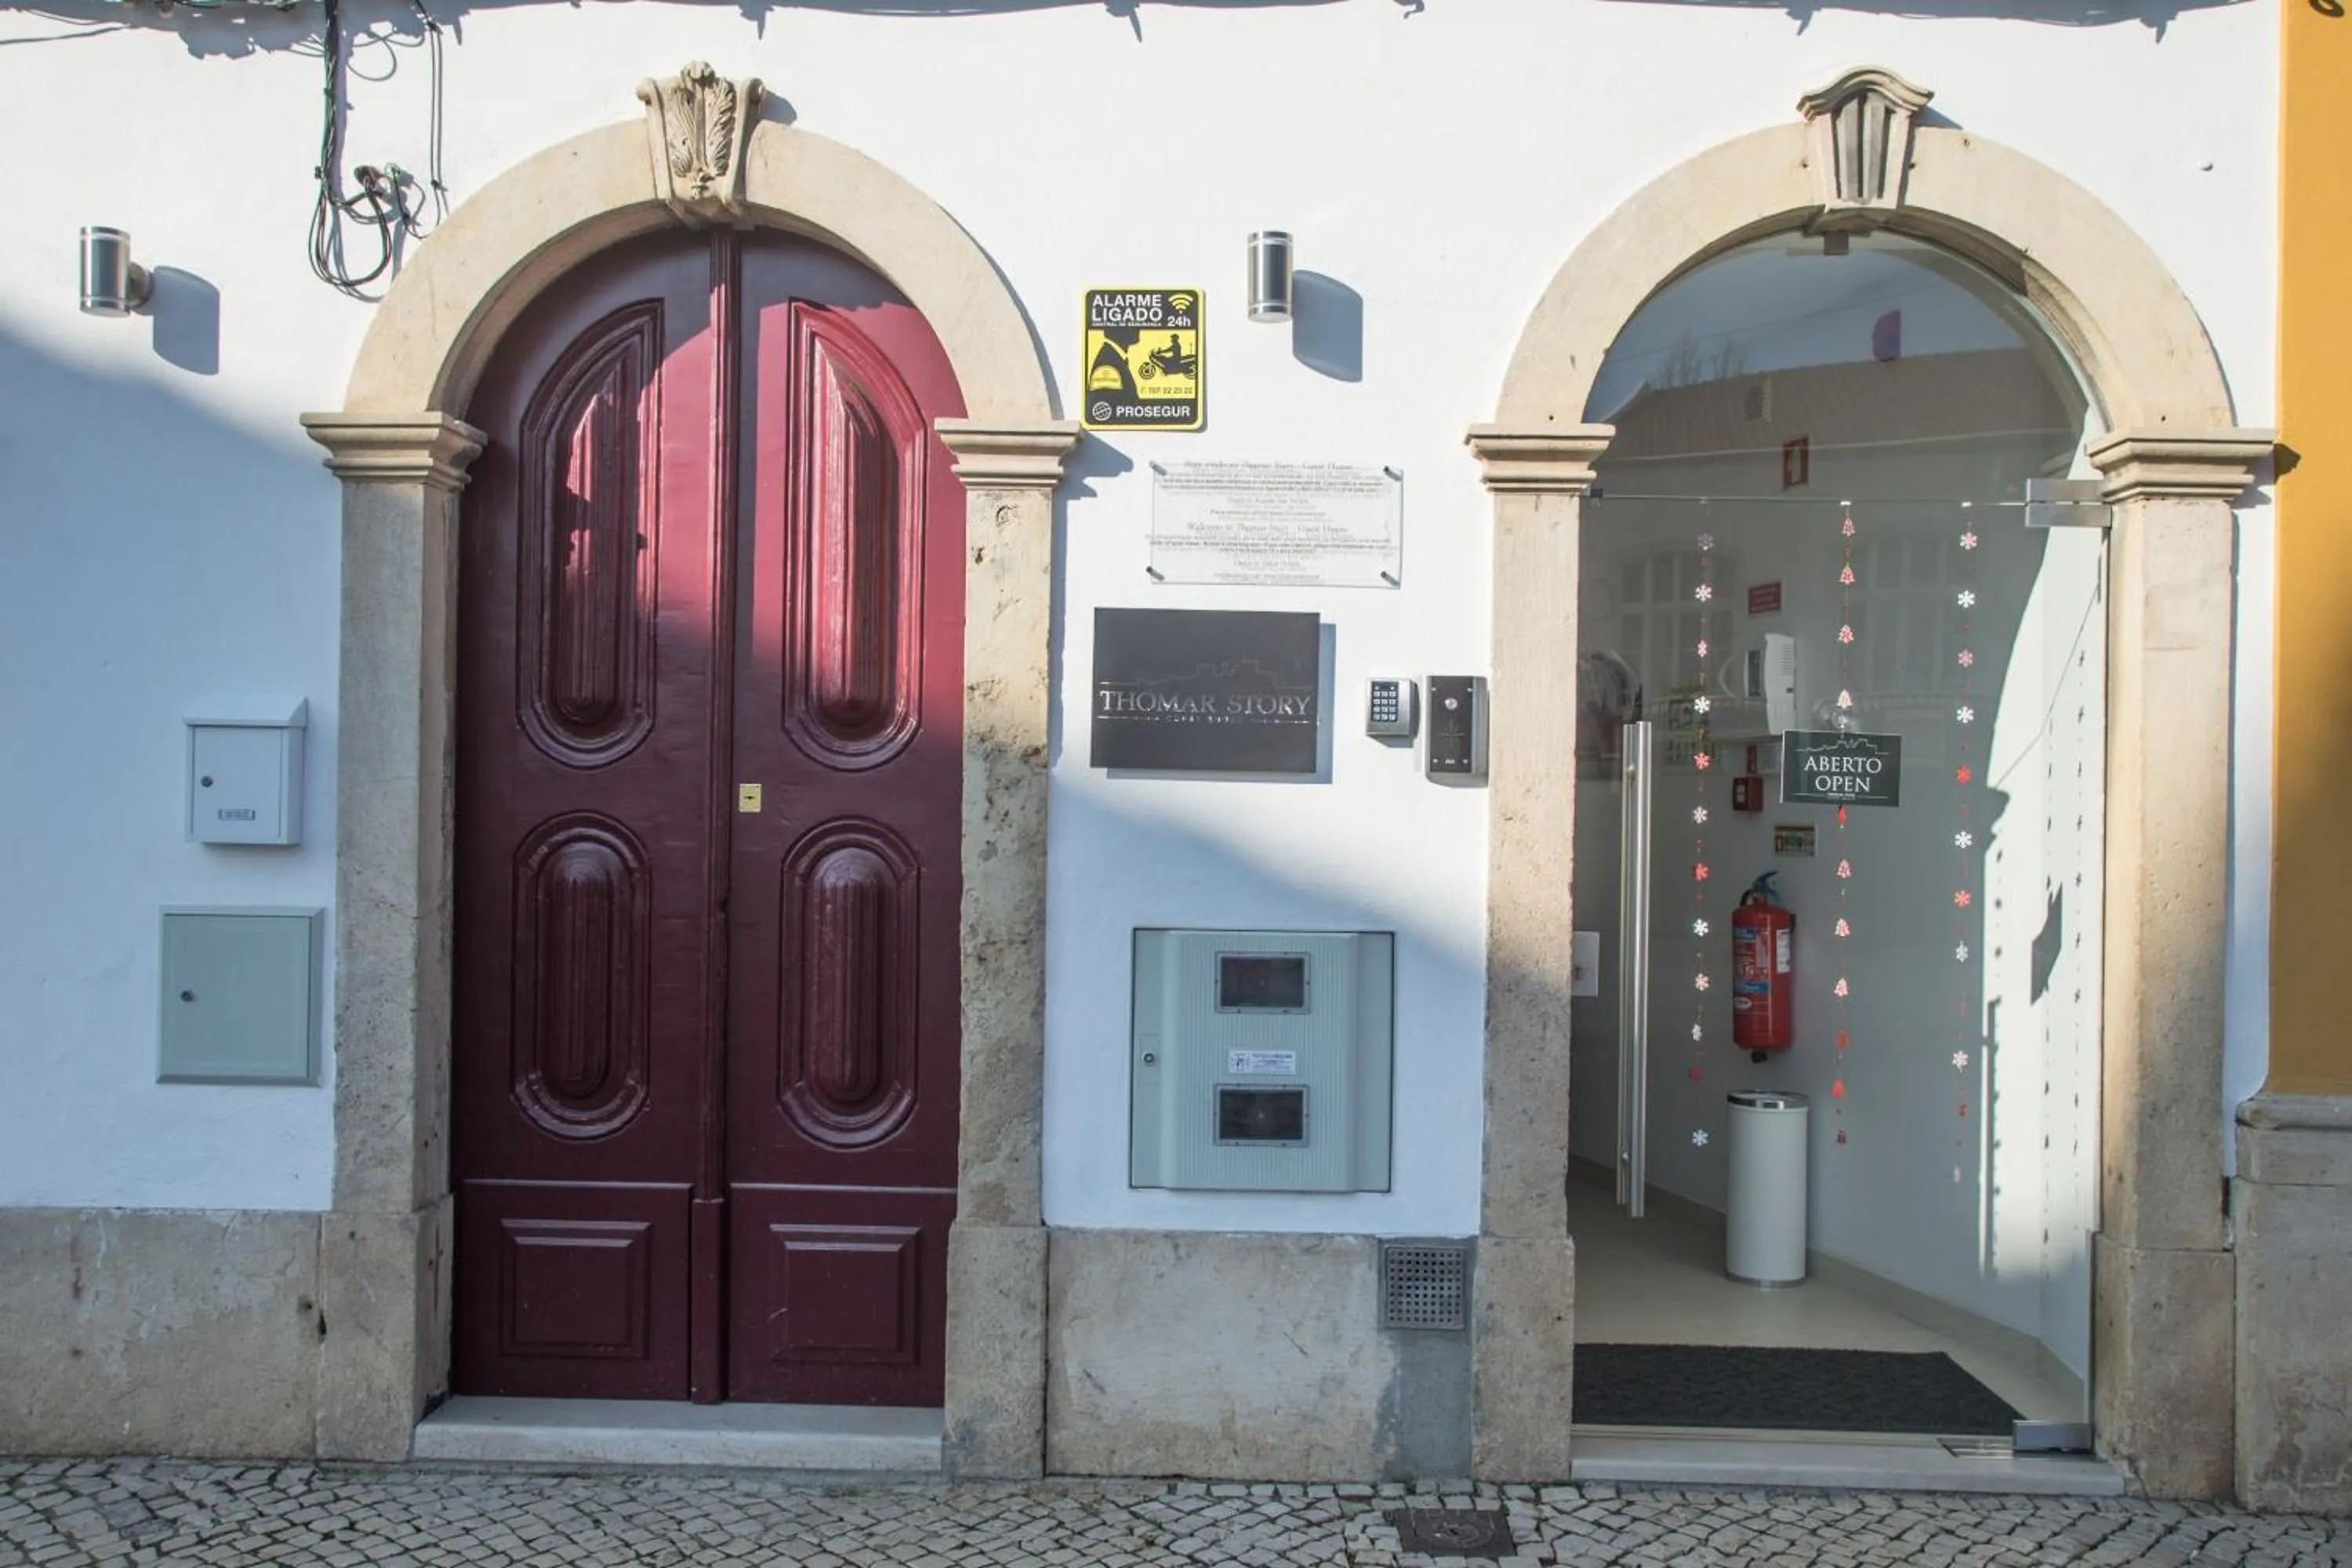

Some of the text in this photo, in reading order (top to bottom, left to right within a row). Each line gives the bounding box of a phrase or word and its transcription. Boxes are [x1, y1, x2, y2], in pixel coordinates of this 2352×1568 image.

[1092, 294, 1162, 307] ALARME
[1092, 307, 1163, 322] LIGADO
[1167, 316, 1192, 327] 24h
[1116, 405, 1191, 418] PROSEGUR
[1099, 691, 1311, 715] THOMAR STORY
[1804, 755, 1882, 774] ABERTO
[1815, 775, 1871, 793] OPEN
